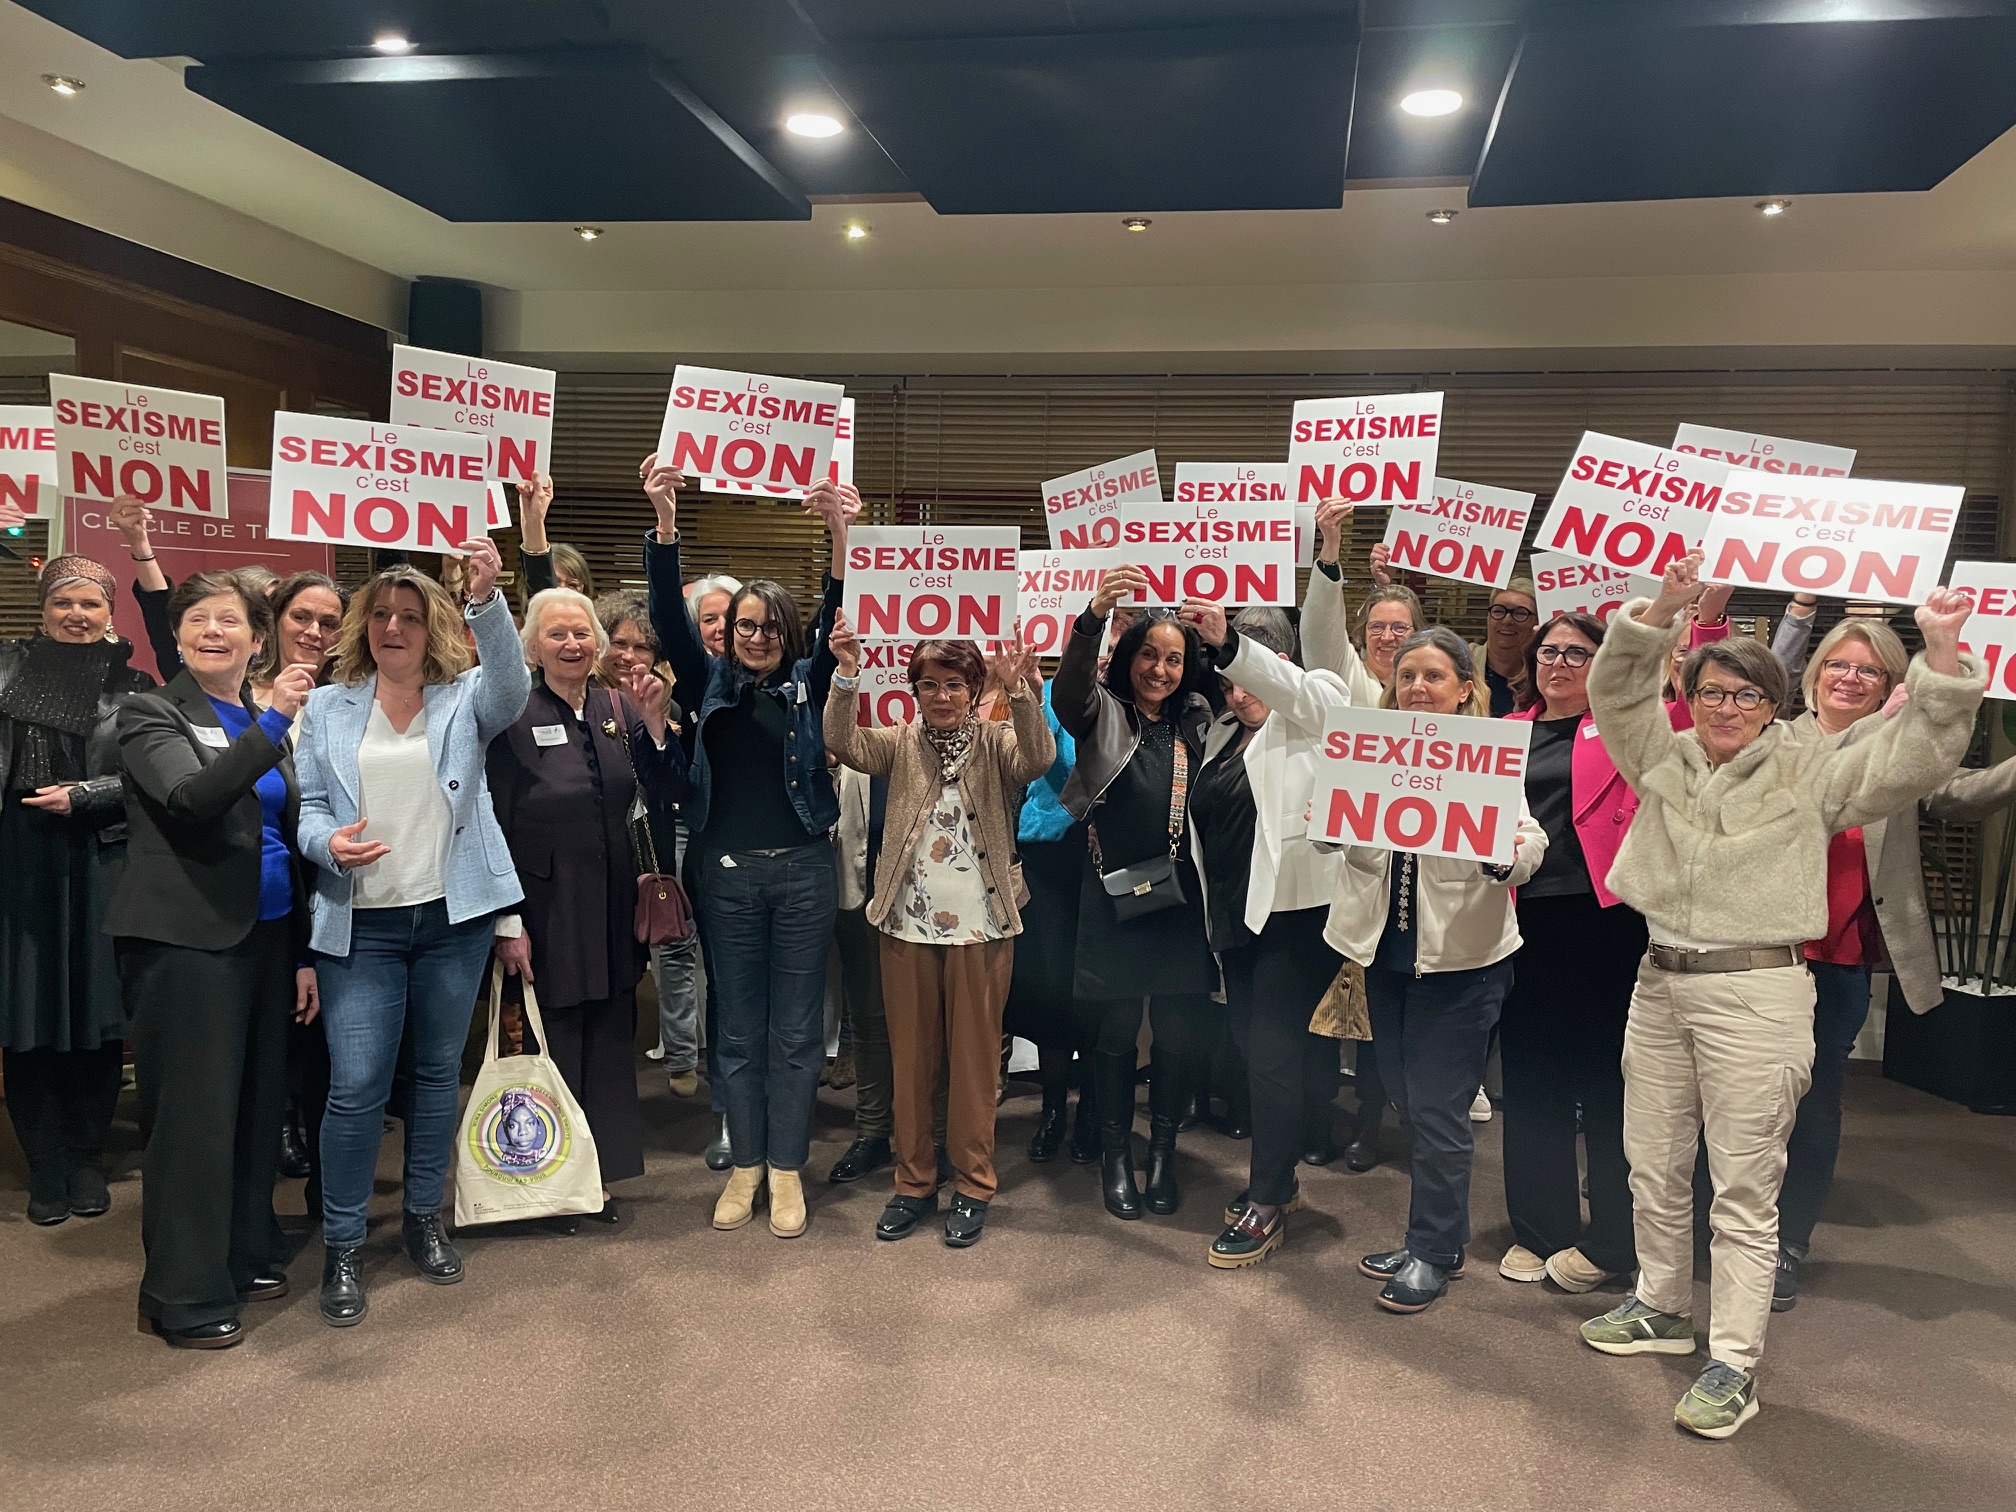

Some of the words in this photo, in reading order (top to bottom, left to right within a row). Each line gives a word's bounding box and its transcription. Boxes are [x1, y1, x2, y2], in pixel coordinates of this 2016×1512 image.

[467, 362, 488, 379] Le
[397, 370, 551, 417] SEXISME
[747, 378, 769, 393] Le
[126, 389, 148, 407] Le
[673, 386, 837, 426] SEXISME
[1356, 401, 1375, 415] Le
[56, 399, 221, 446] SEXISME
[455, 409, 494, 428] c'est
[729, 418, 771, 435] c'est
[1294, 414, 1437, 442] SEXISME
[371, 427, 397, 444] Le
[119, 436, 161, 456] c'est
[1343, 442, 1380, 457] c'est
[1750, 438, 1774, 455] Le
[278, 436, 484, 481] SEXISME
[672, 431, 815, 486] NON
[1654, 452, 1679, 473] Le
[72, 451, 211, 512] NON
[356, 473, 409, 493] c'est
[1090, 468, 1106, 482] Le
[1237, 467, 1256, 480] Le
[1298, 461, 1421, 502] NON
[1572, 454, 1722, 513] SEXISM
[1047, 466, 1157, 514] SEXISME
[1177, 482, 1286, 502] SEXISM
[1456, 485, 1474, 499] Le
[1089, 501, 1118, 516] c'est
[1196, 506, 1218, 519] Le
[1623, 495, 1670, 522] c'est
[1720, 491, 1953, 534] SEXISME
[82, 513, 192, 535] CECLE
[203, 523, 236, 538] DE
[291, 490, 468, 549] NON
[1438, 521, 1471, 537] c'est
[922, 530, 944, 545] Le
[1060, 516, 1121, 549] NO
[1124, 520, 1291, 543] SEXISME
[1795, 523, 1856, 543] c'est
[849, 547, 1016, 571] SEXISME
[1043, 554, 1060, 568] Le
[1185, 545, 1228, 558] c'est
[1390, 530, 1504, 583] NON
[1712, 537, 1920, 599] NON
[909, 574, 952, 588] c'est
[1018, 569, 1110, 592] XISM
[1134, 564, 1278, 602] NON
[1592, 581, 1630, 598] c'est
[1029, 594, 1062, 608] c'est
[857, 594, 1001, 635] NON
[876, 670, 908, 685] c'es
[1411, 717, 1438, 736] Le
[1325, 731, 1524, 777] SEXISME
[1391, 769, 1443, 791] c'est
[1326, 789, 1499, 857] NON
[529, 1172, 546, 1182] VOUS
